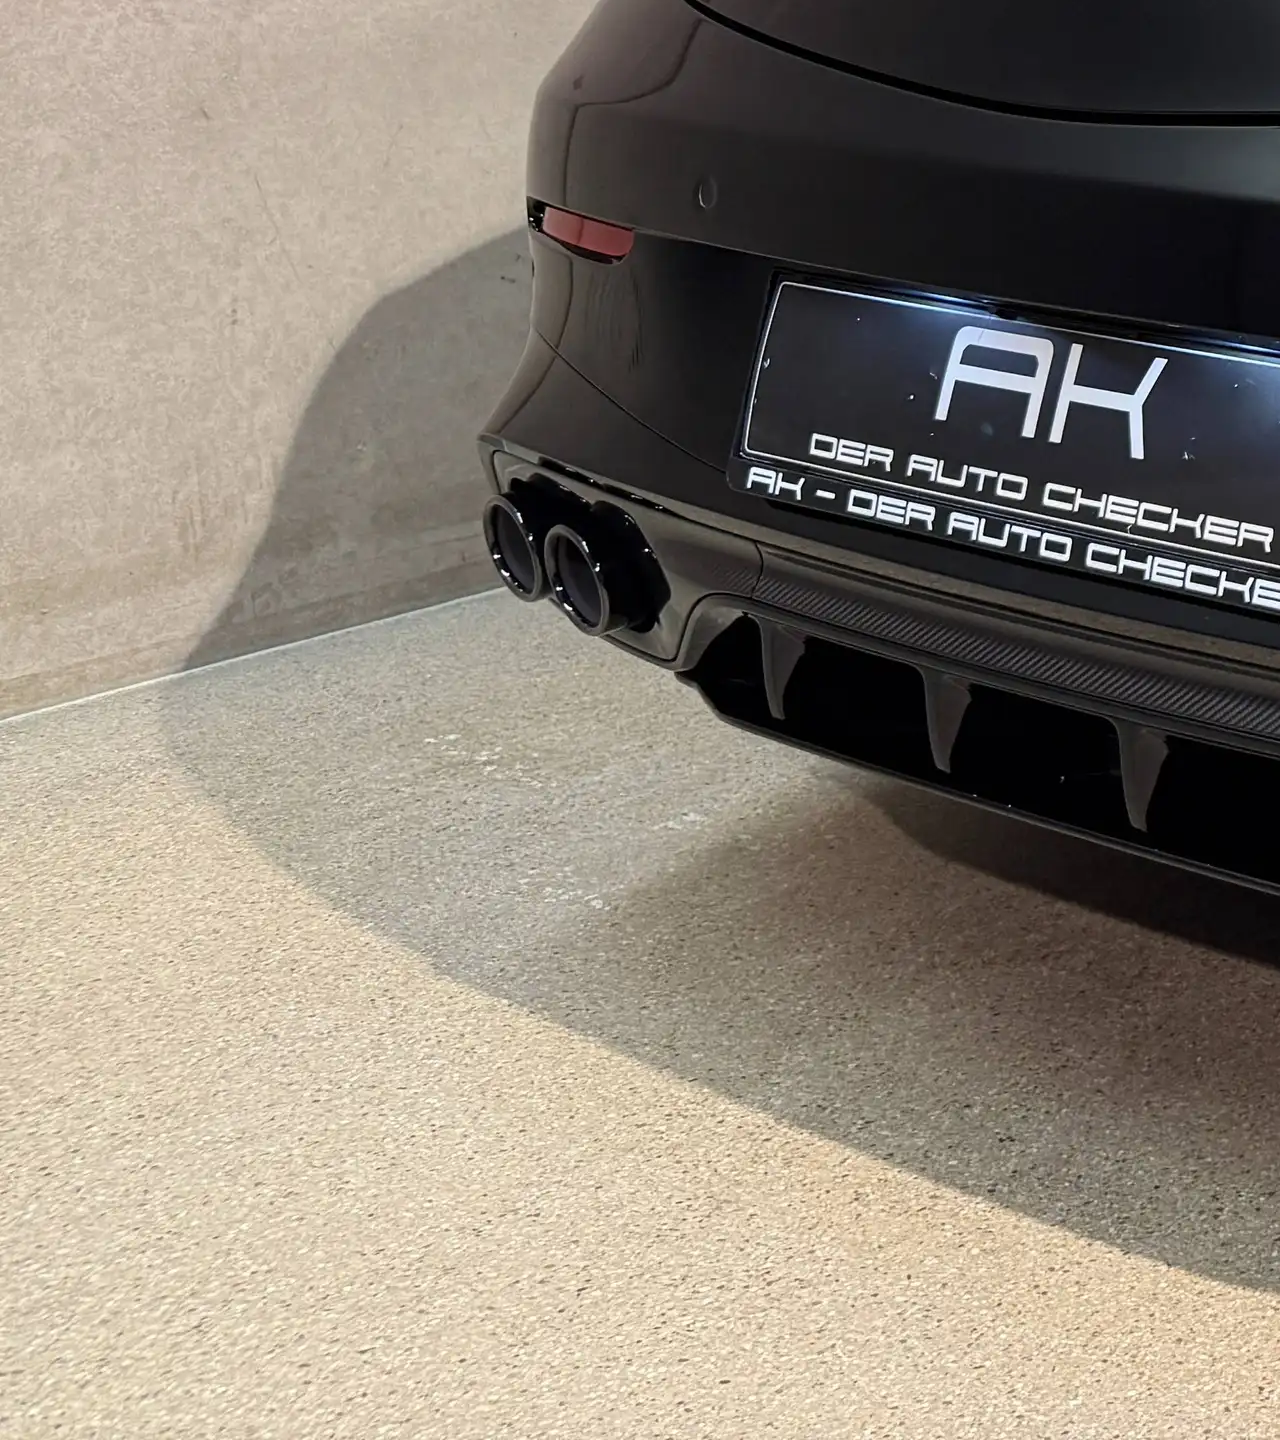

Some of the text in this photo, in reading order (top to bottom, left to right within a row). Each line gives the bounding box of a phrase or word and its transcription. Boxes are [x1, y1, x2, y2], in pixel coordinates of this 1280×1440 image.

[934, 325, 1168, 460] AK
[745, 465, 805, 499] AK
[846, 491, 935, 531] DER
[947, 511, 1072, 563] AUTO
[809, 433, 1275, 552] DER AUTO CHECKER
